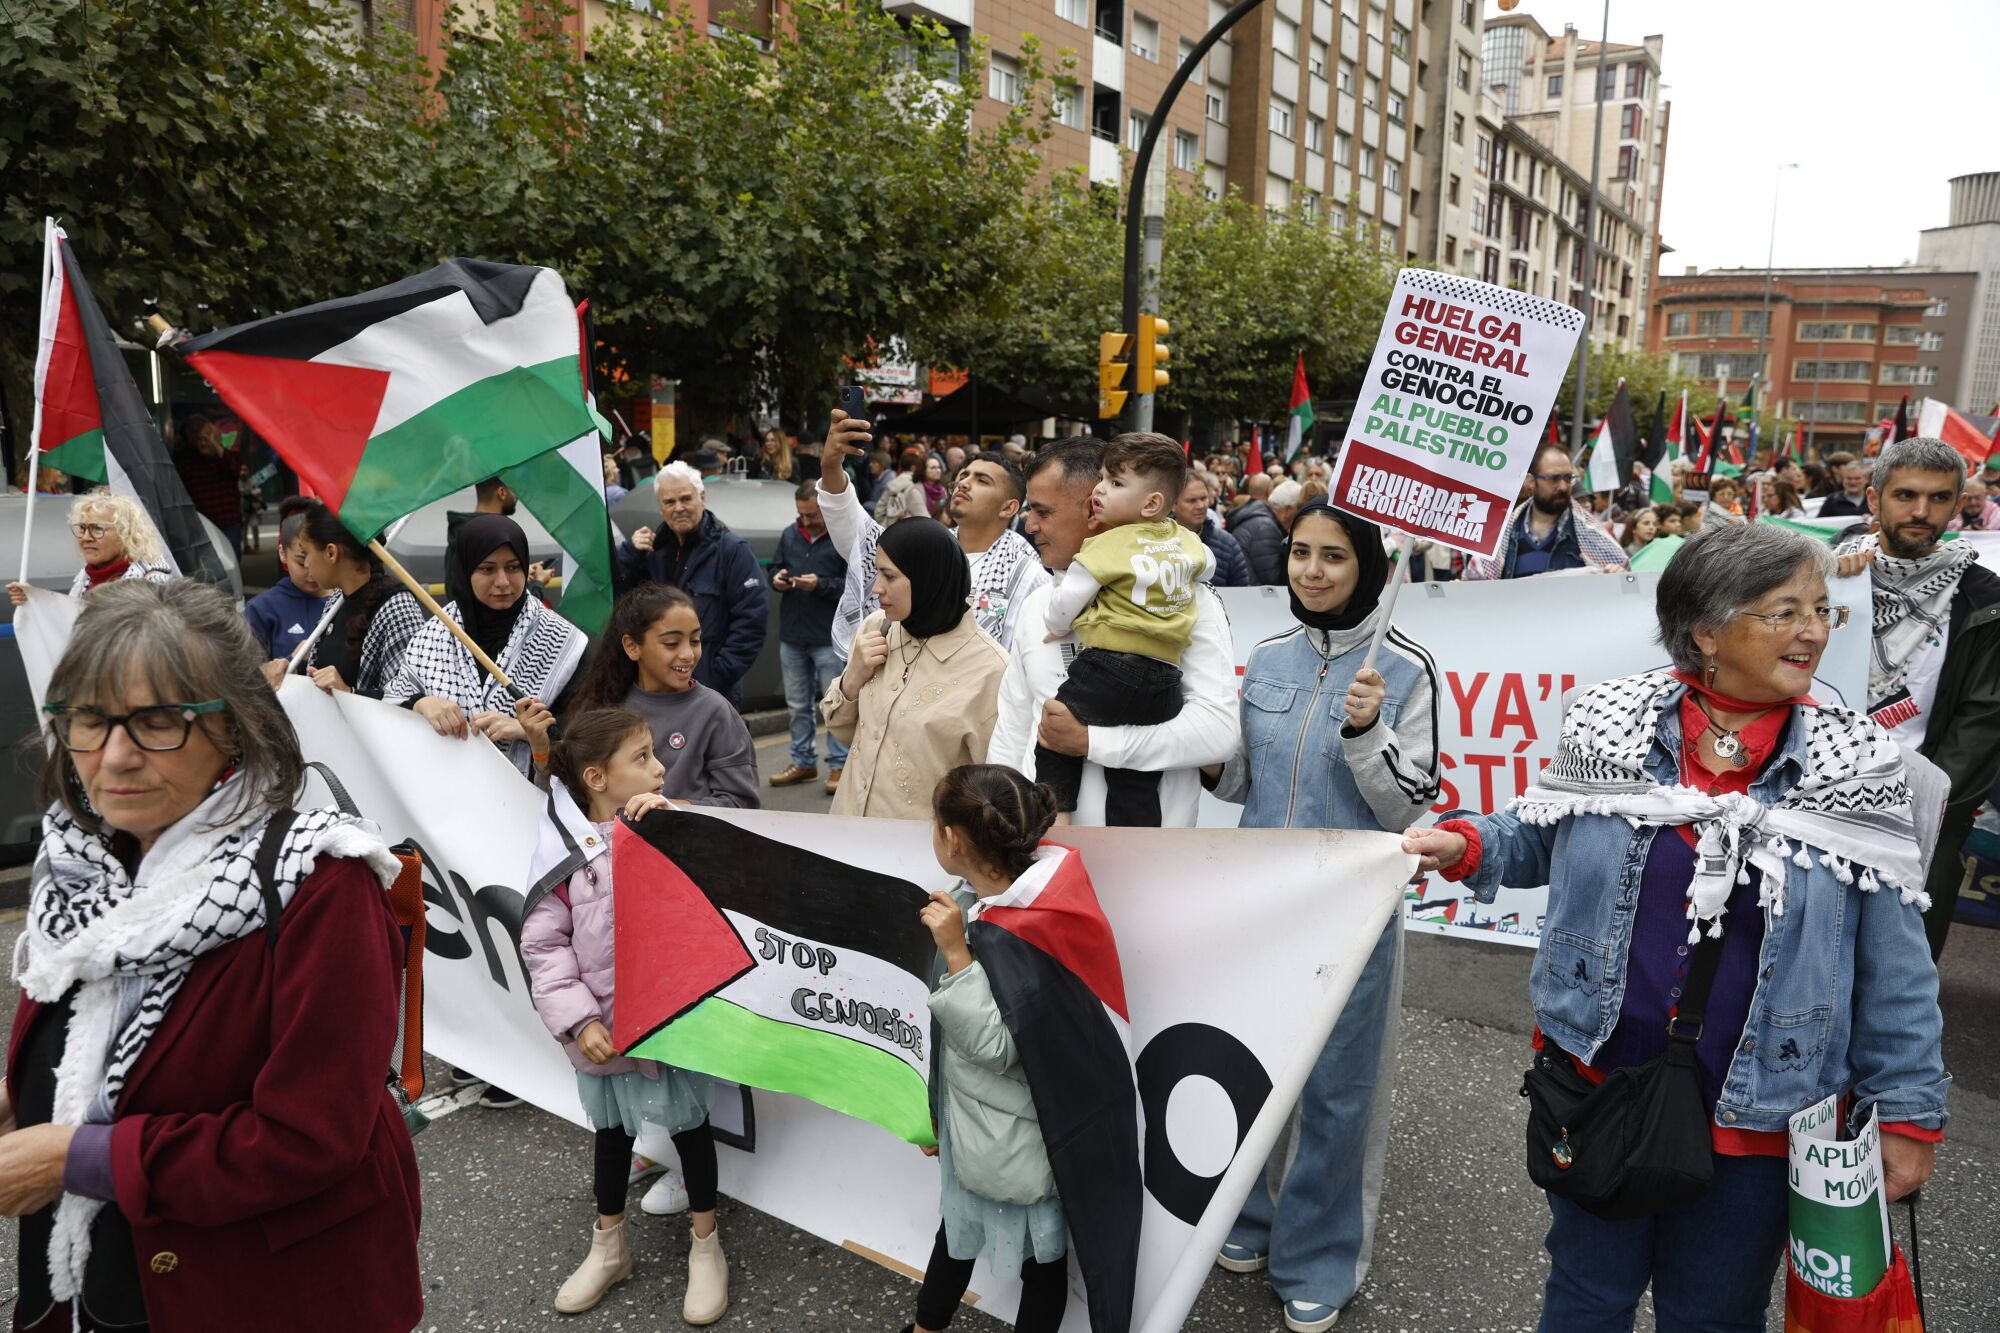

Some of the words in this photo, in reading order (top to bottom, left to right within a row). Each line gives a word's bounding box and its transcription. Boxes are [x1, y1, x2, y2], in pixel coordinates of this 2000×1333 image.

[1401, 294, 1522, 347] HUELGA
[1386, 349, 1475, 388] CONTRA
[1480, 375, 1504, 396] EL
[1394, 321, 1530, 378] GENERAL
[1370, 393, 1404, 419] AL
[1408, 401, 1509, 446] PUEBLO
[1380, 367, 1534, 426] GENOCIDIO
[1363, 415, 1507, 471] PALESTINO
[1345, 485, 1485, 544] REVOLUCIONARIA
[1354, 463, 1463, 518] IZQUIERDA
[1445, 671, 1575, 740] YA'
[755, 928, 837, 975] STOP
[1790, 1229, 1852, 1283] NO!
